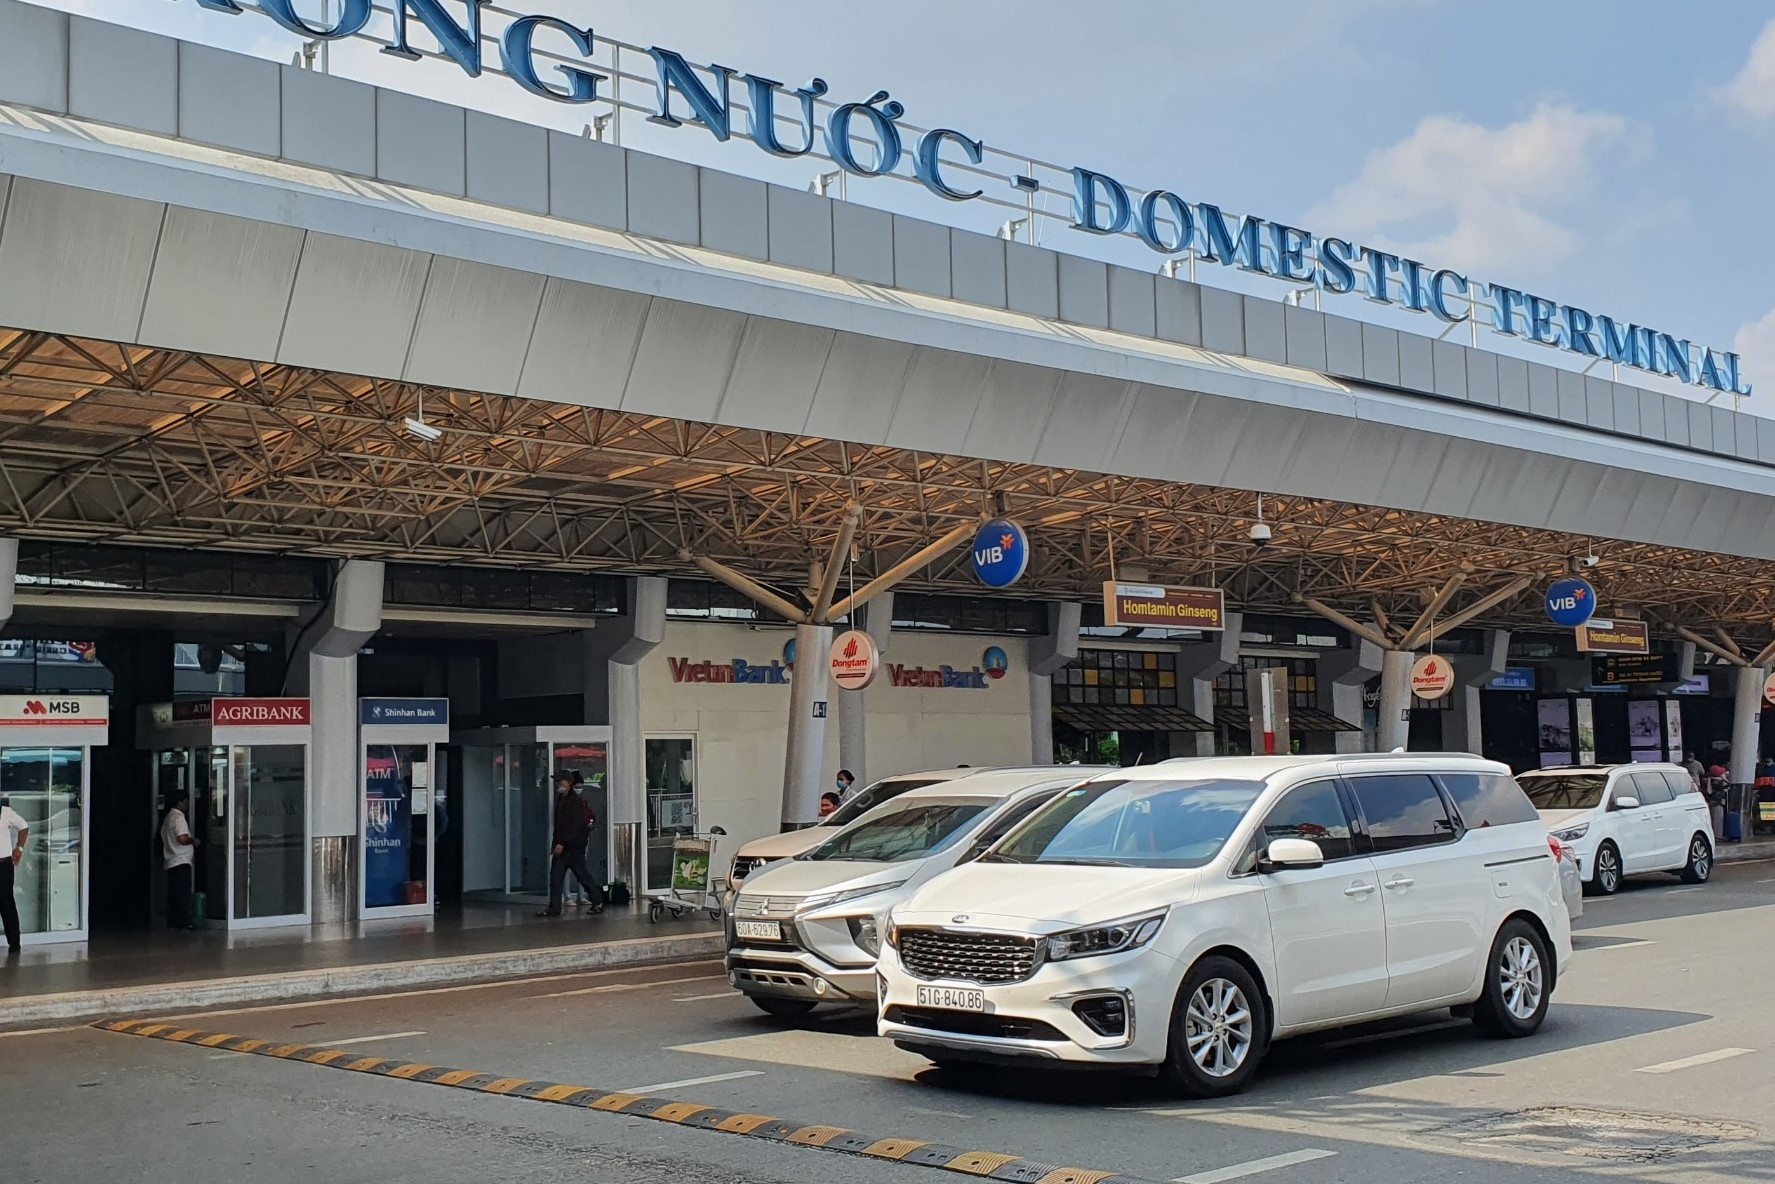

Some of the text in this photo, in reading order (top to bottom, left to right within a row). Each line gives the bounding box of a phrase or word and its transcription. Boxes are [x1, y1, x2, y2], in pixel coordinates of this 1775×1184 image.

[645, 45, 984, 201] NƯỚC
[1068, 165, 1470, 323] DOMESTIC
[1482, 282, 1752, 397] TERMINAL
[974, 546, 1004, 567] VIB
[1123, 599, 1218, 622] Homtamin Ginseng
[1549, 596, 1577, 612] VIB
[832, 659, 868, 669] Dongtam
[48, 701, 81, 714] MSB
[193, 702, 211, 714] ATM
[217, 706, 304, 720] AGRIBANK
[384, 708, 436, 717] Shinhan Bank
[366, 767, 391, 780] ATM
[919, 987, 982, 1009] 51G-840.86
